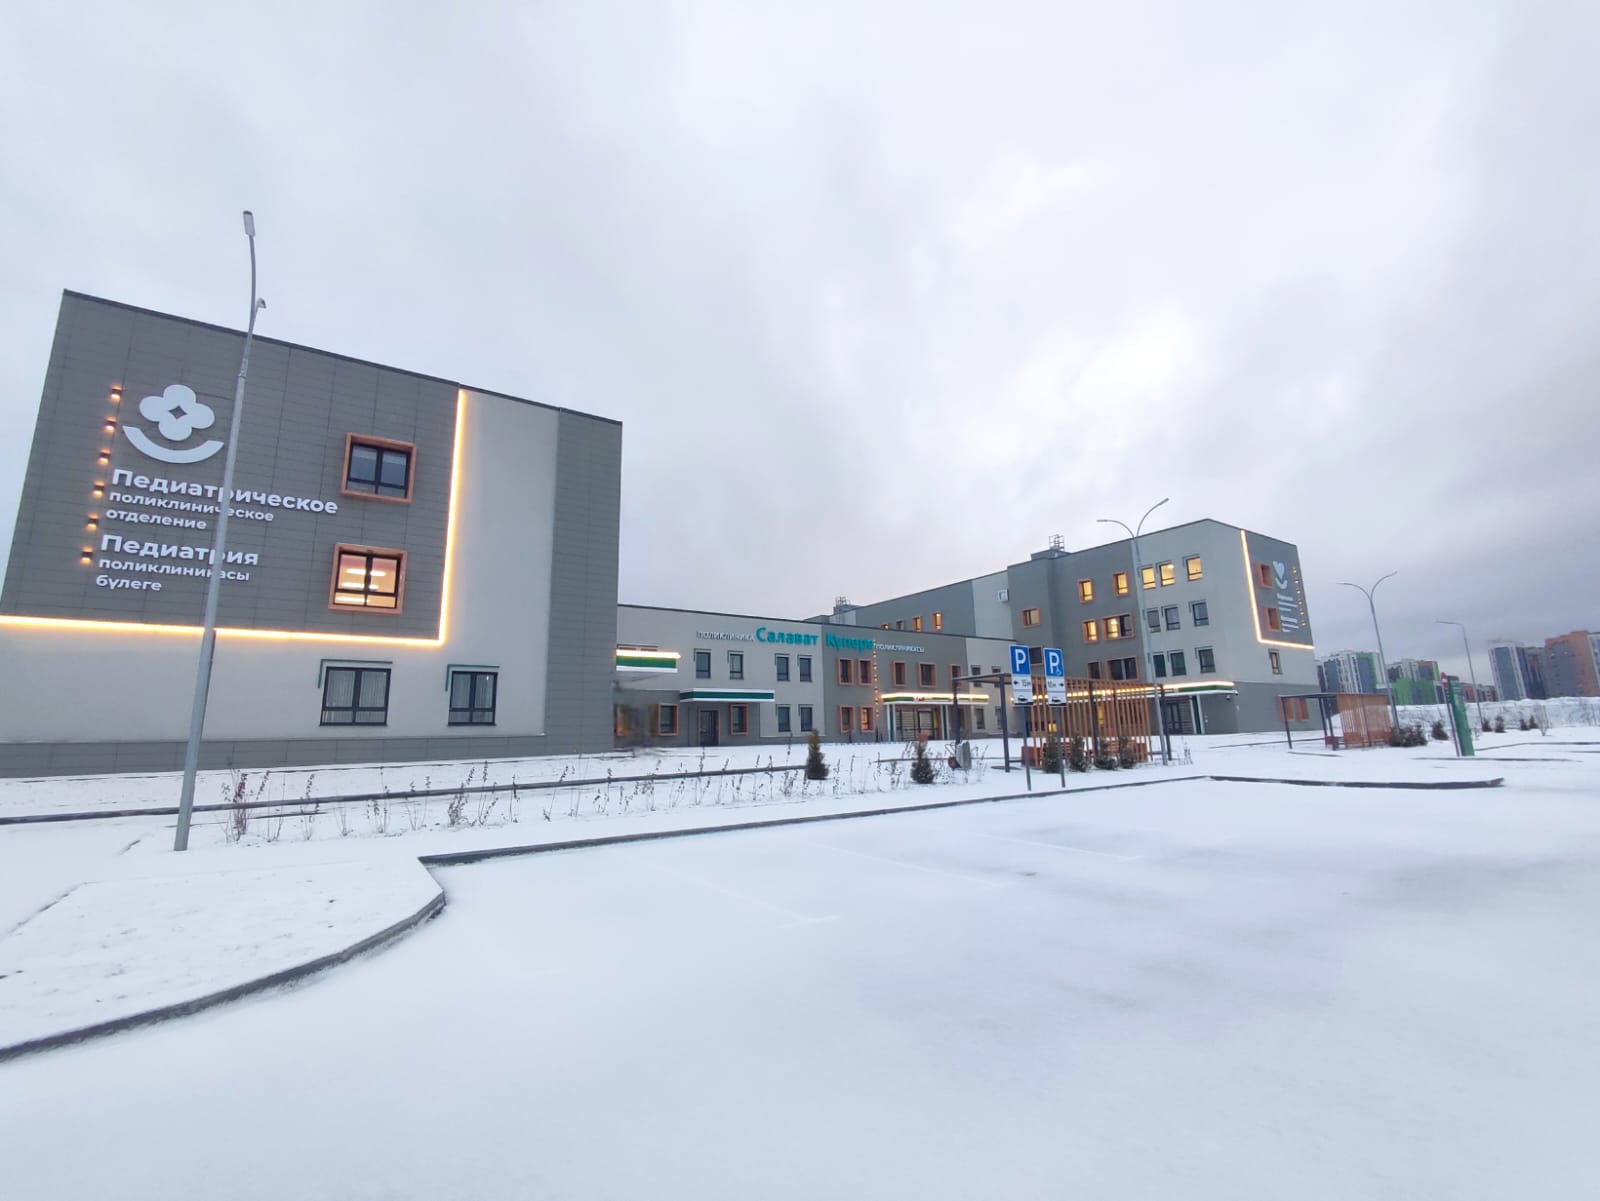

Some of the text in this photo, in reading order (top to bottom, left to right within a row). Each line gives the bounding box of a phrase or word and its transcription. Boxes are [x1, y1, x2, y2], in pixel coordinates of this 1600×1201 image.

[106, 509, 207, 529] отделение
[755, 626, 819, 646] Салават
[1015, 648, 1026, 672] P
[1049, 651, 1060, 674] P
